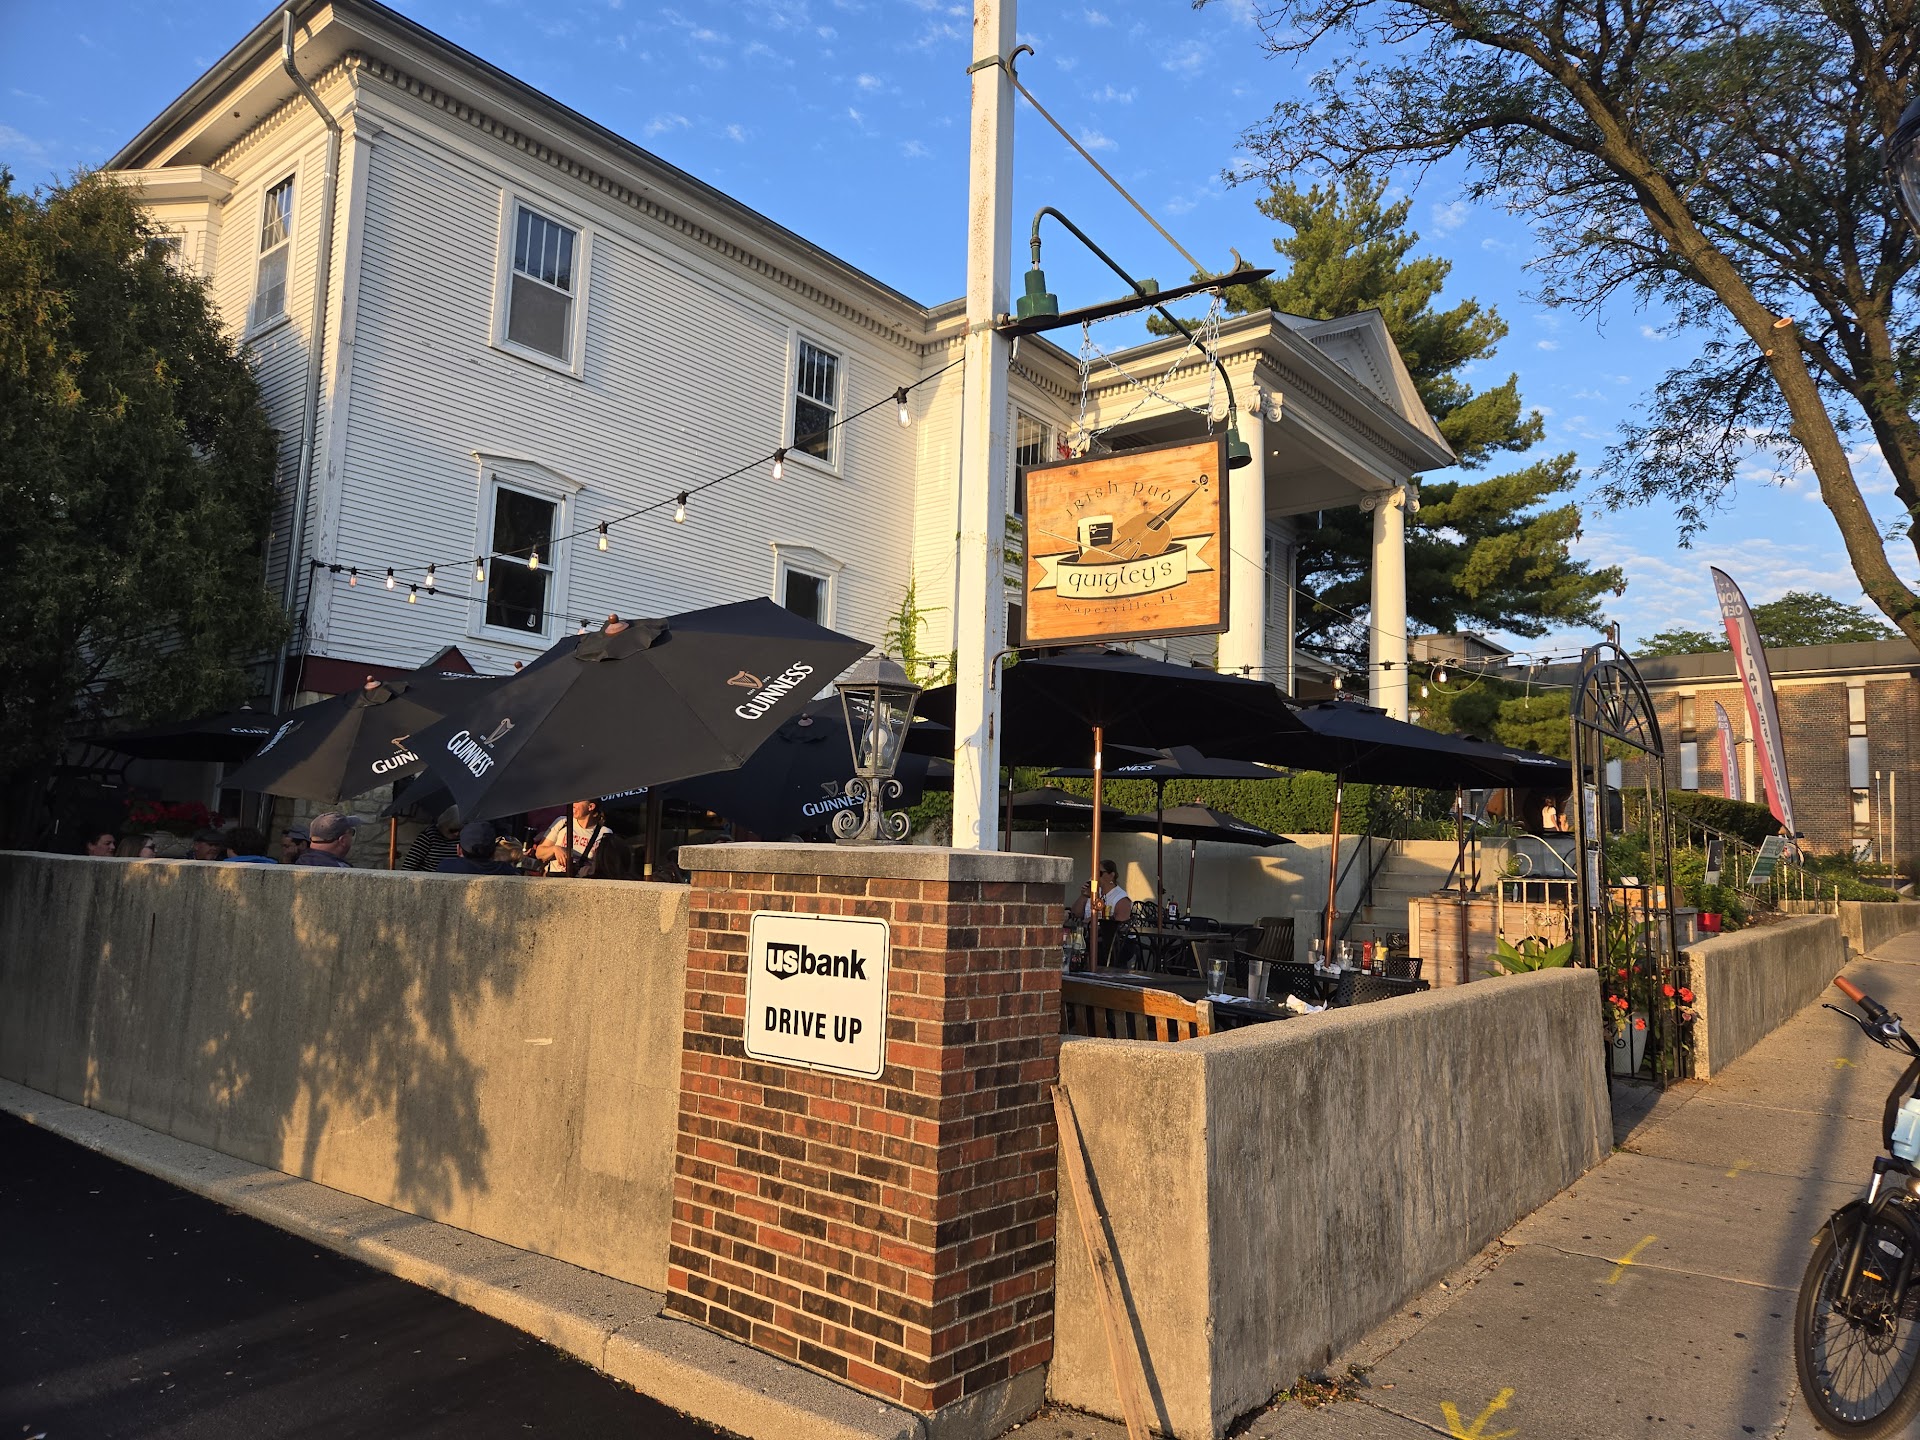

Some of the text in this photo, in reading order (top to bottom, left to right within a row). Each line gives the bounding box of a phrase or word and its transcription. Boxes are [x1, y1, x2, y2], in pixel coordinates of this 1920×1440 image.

[1133, 482, 1171, 503] pub
[1068, 561, 1173, 594] quigley's
[735, 661, 814, 720] GUINNESS
[231, 727, 269, 735] GUIN
[371, 751, 419, 774] GUIN
[447, 730, 494, 778] GUINNESS
[765, 1006, 862, 1044] DRIVE UP
